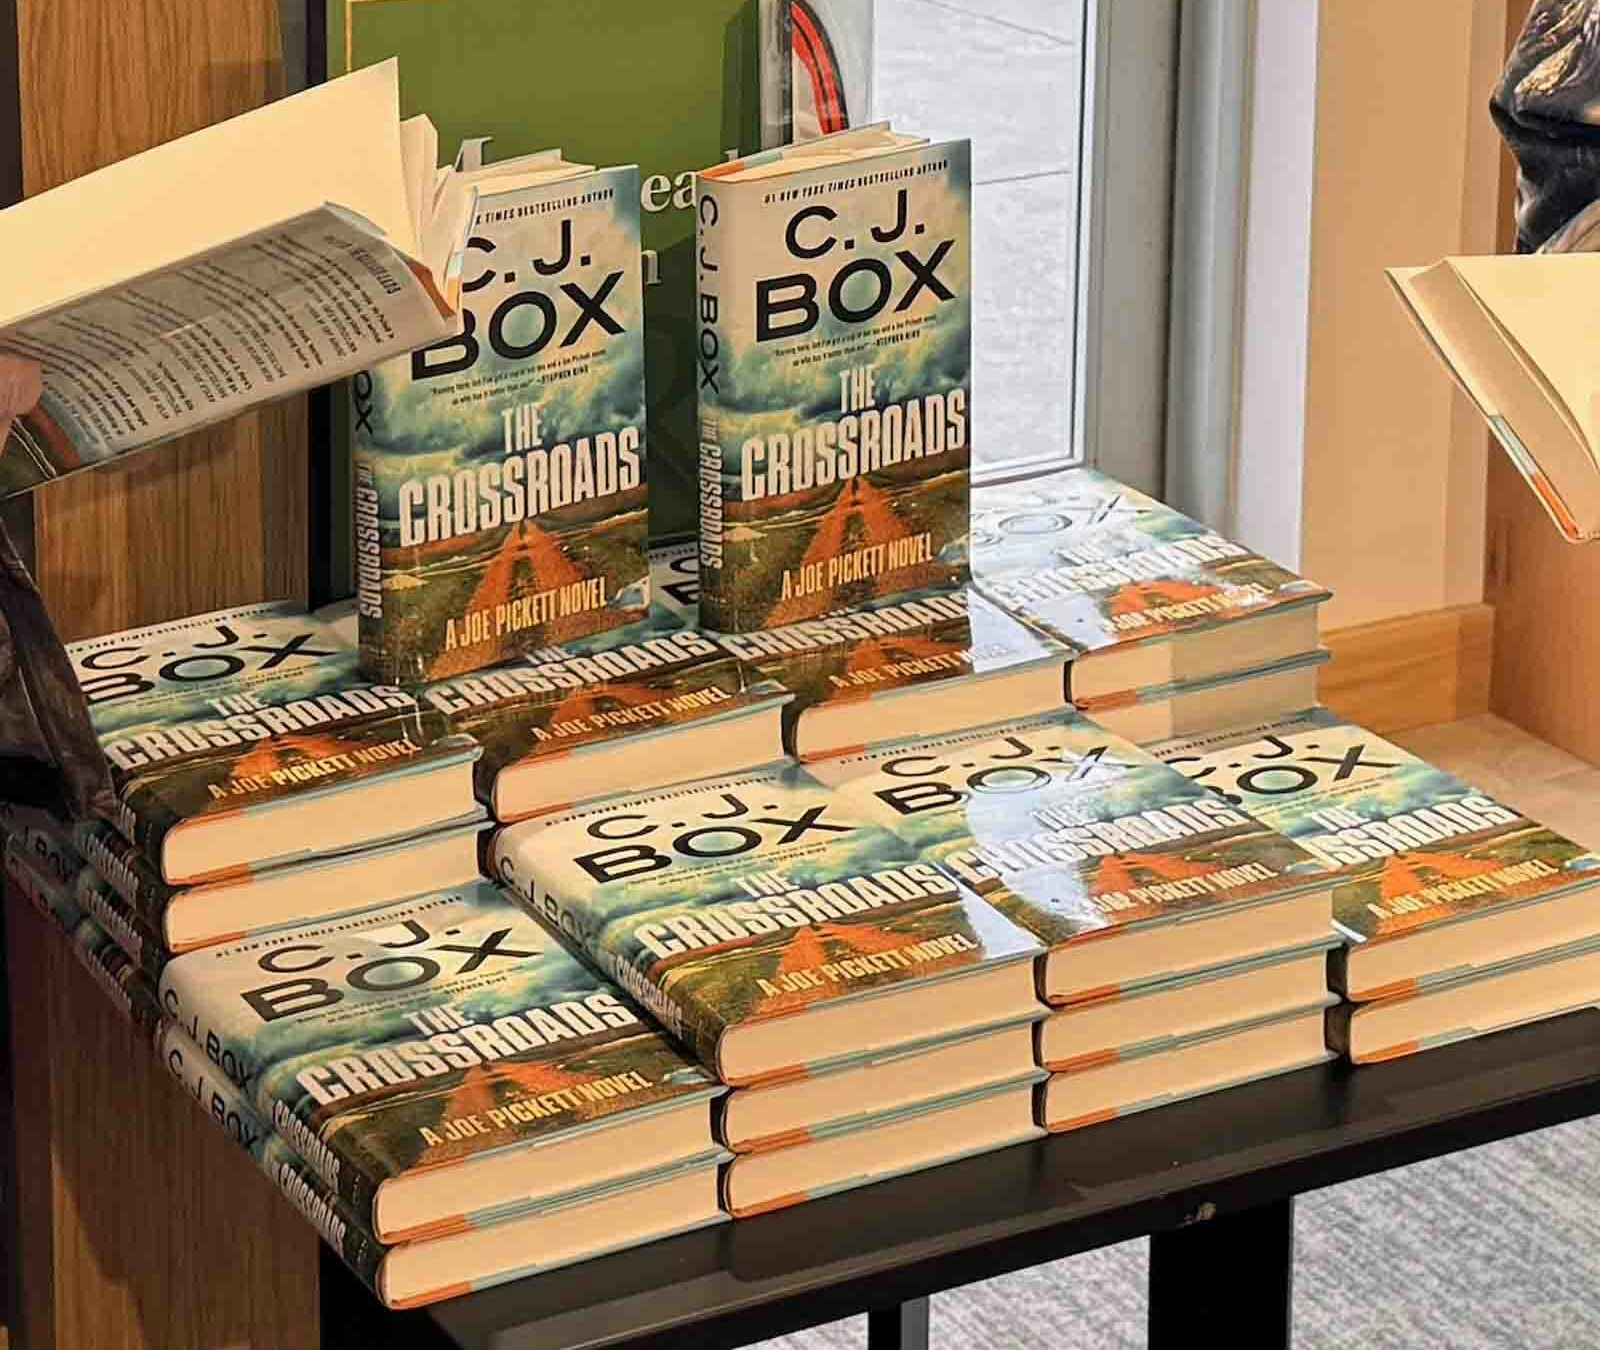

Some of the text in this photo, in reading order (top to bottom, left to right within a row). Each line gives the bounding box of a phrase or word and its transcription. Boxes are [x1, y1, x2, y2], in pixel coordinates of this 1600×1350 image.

[485, 188, 615, 225] TIMES BESTSELLING AUTHOR
[779, 158, 949, 202] NEW YORK TIMES BESTSELLING AUTHOR
[461, 218, 592, 293] C. J.
[785, 188, 926, 259] C. J.
[410, 269, 627, 382] BOX
[755, 238, 956, 343] BOX
[699, 296, 720, 395] BOX
[501, 402, 543, 453] THE
[838, 367, 877, 415] THE
[740, 387, 967, 502] CROSSROADS
[399, 425, 641, 549] CROSSROADS
[700, 438, 724, 570] CROSSROADS
[781, 532, 934, 602] A JOE PICKETT NOVEL
[445, 575, 608, 651] A JOE PICKETT NOVEL
[103, 684, 424, 772] CROSSROADS
[572, 804, 856, 885] BOX
[946, 796, 1252, 887] CROSSROADS
[1426, 857, 1560, 903] PICKETT NOVEL
[257, 920, 461, 974] C. J.
[633, 860, 961, 960] CROSSROADS
[239, 927, 544, 1023] BOX
[821, 928, 979, 981] PICKETT NOVEL
[295, 993, 642, 1107] CROSSROADS
[407, 1004, 476, 1036] THE
[418, 1069, 655, 1147] A JOE PICKETT NOVEL
